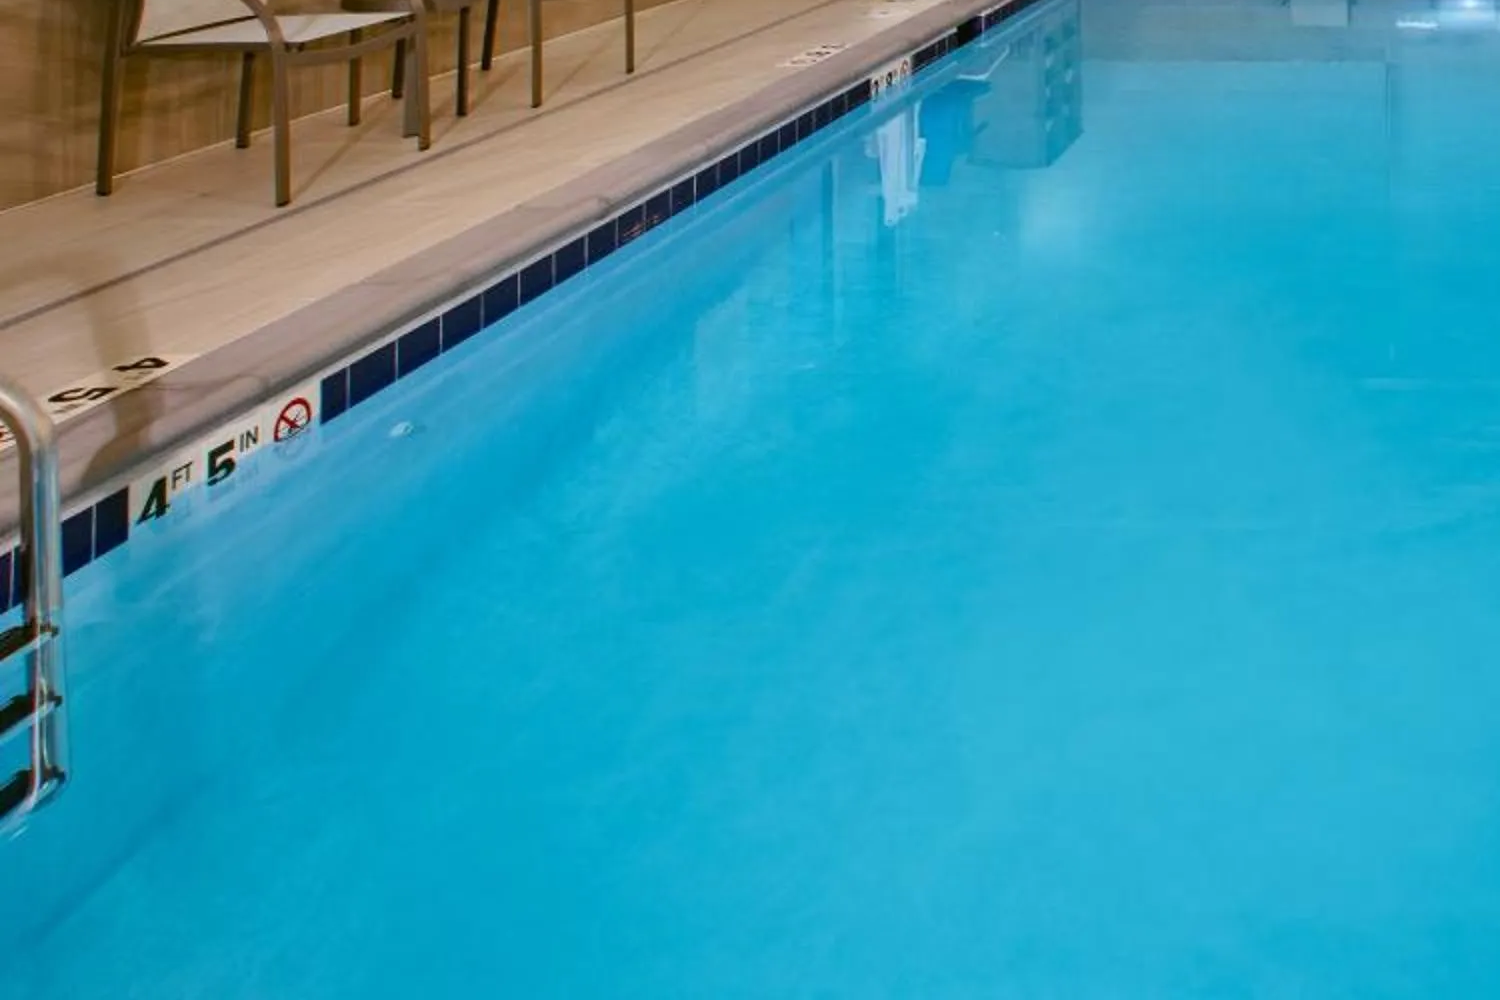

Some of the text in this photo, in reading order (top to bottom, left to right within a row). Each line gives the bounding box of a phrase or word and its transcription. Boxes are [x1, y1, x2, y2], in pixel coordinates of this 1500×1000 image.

[136, 425, 260, 525] 4 FT 5 IN
